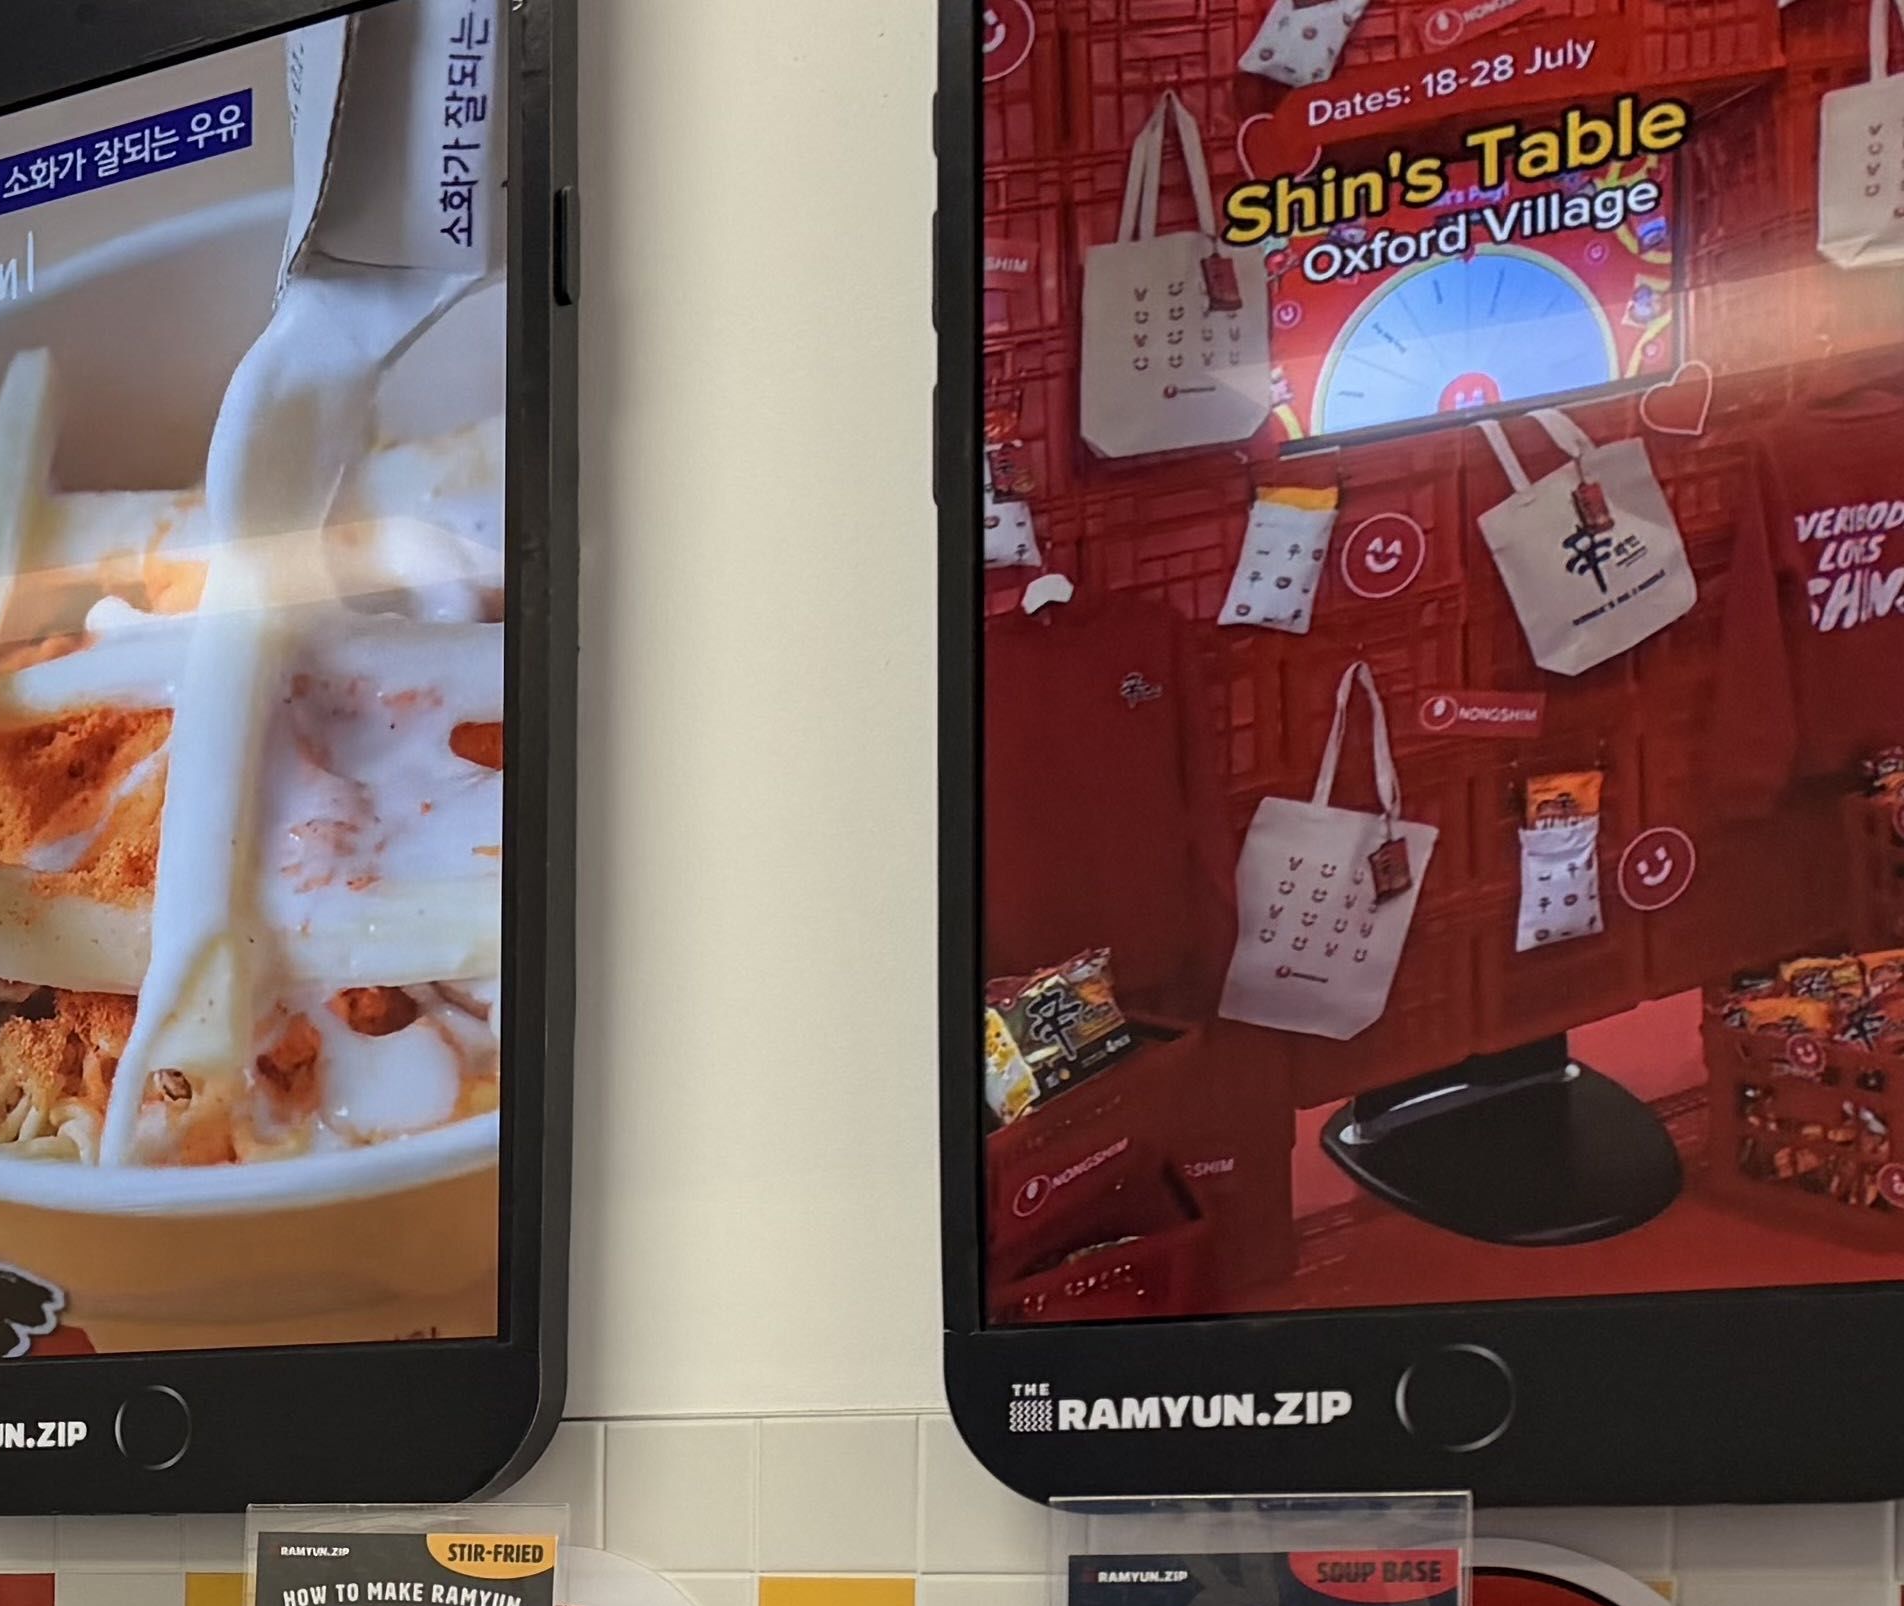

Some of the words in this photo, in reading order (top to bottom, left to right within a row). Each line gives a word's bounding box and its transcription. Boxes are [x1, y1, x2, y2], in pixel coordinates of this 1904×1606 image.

[445, 4, 491, 128] 잘되는
[1308, 83, 1411, 127] Dates:
[1421, 54, 1514, 100] 18-28
[1524, 37, 1594, 77] July
[3, 155, 87, 200] 소화가
[93, 121, 179, 180] 잘되는
[187, 104, 245, 151] 우유
[440, 139, 478, 247] 소화가
[1225, 148, 1443, 244] Shin's
[1468, 95, 1688, 178] Table
[1302, 215, 1467, 283] Oxford
[1483, 178, 1659, 244] Village
[1011, 1384, 1050, 1397] THE
[1057, 1391, 1352, 1432] RAMYUN.ZIP
[336, 1583, 360, 1601] TO
[367, 1582, 424, 1602] MAKE
[447, 1543, 544, 1564] STIR-FRIED
[1316, 1561, 1376, 1583] SOUP
[1382, 1560, 1442, 1583] BASE
